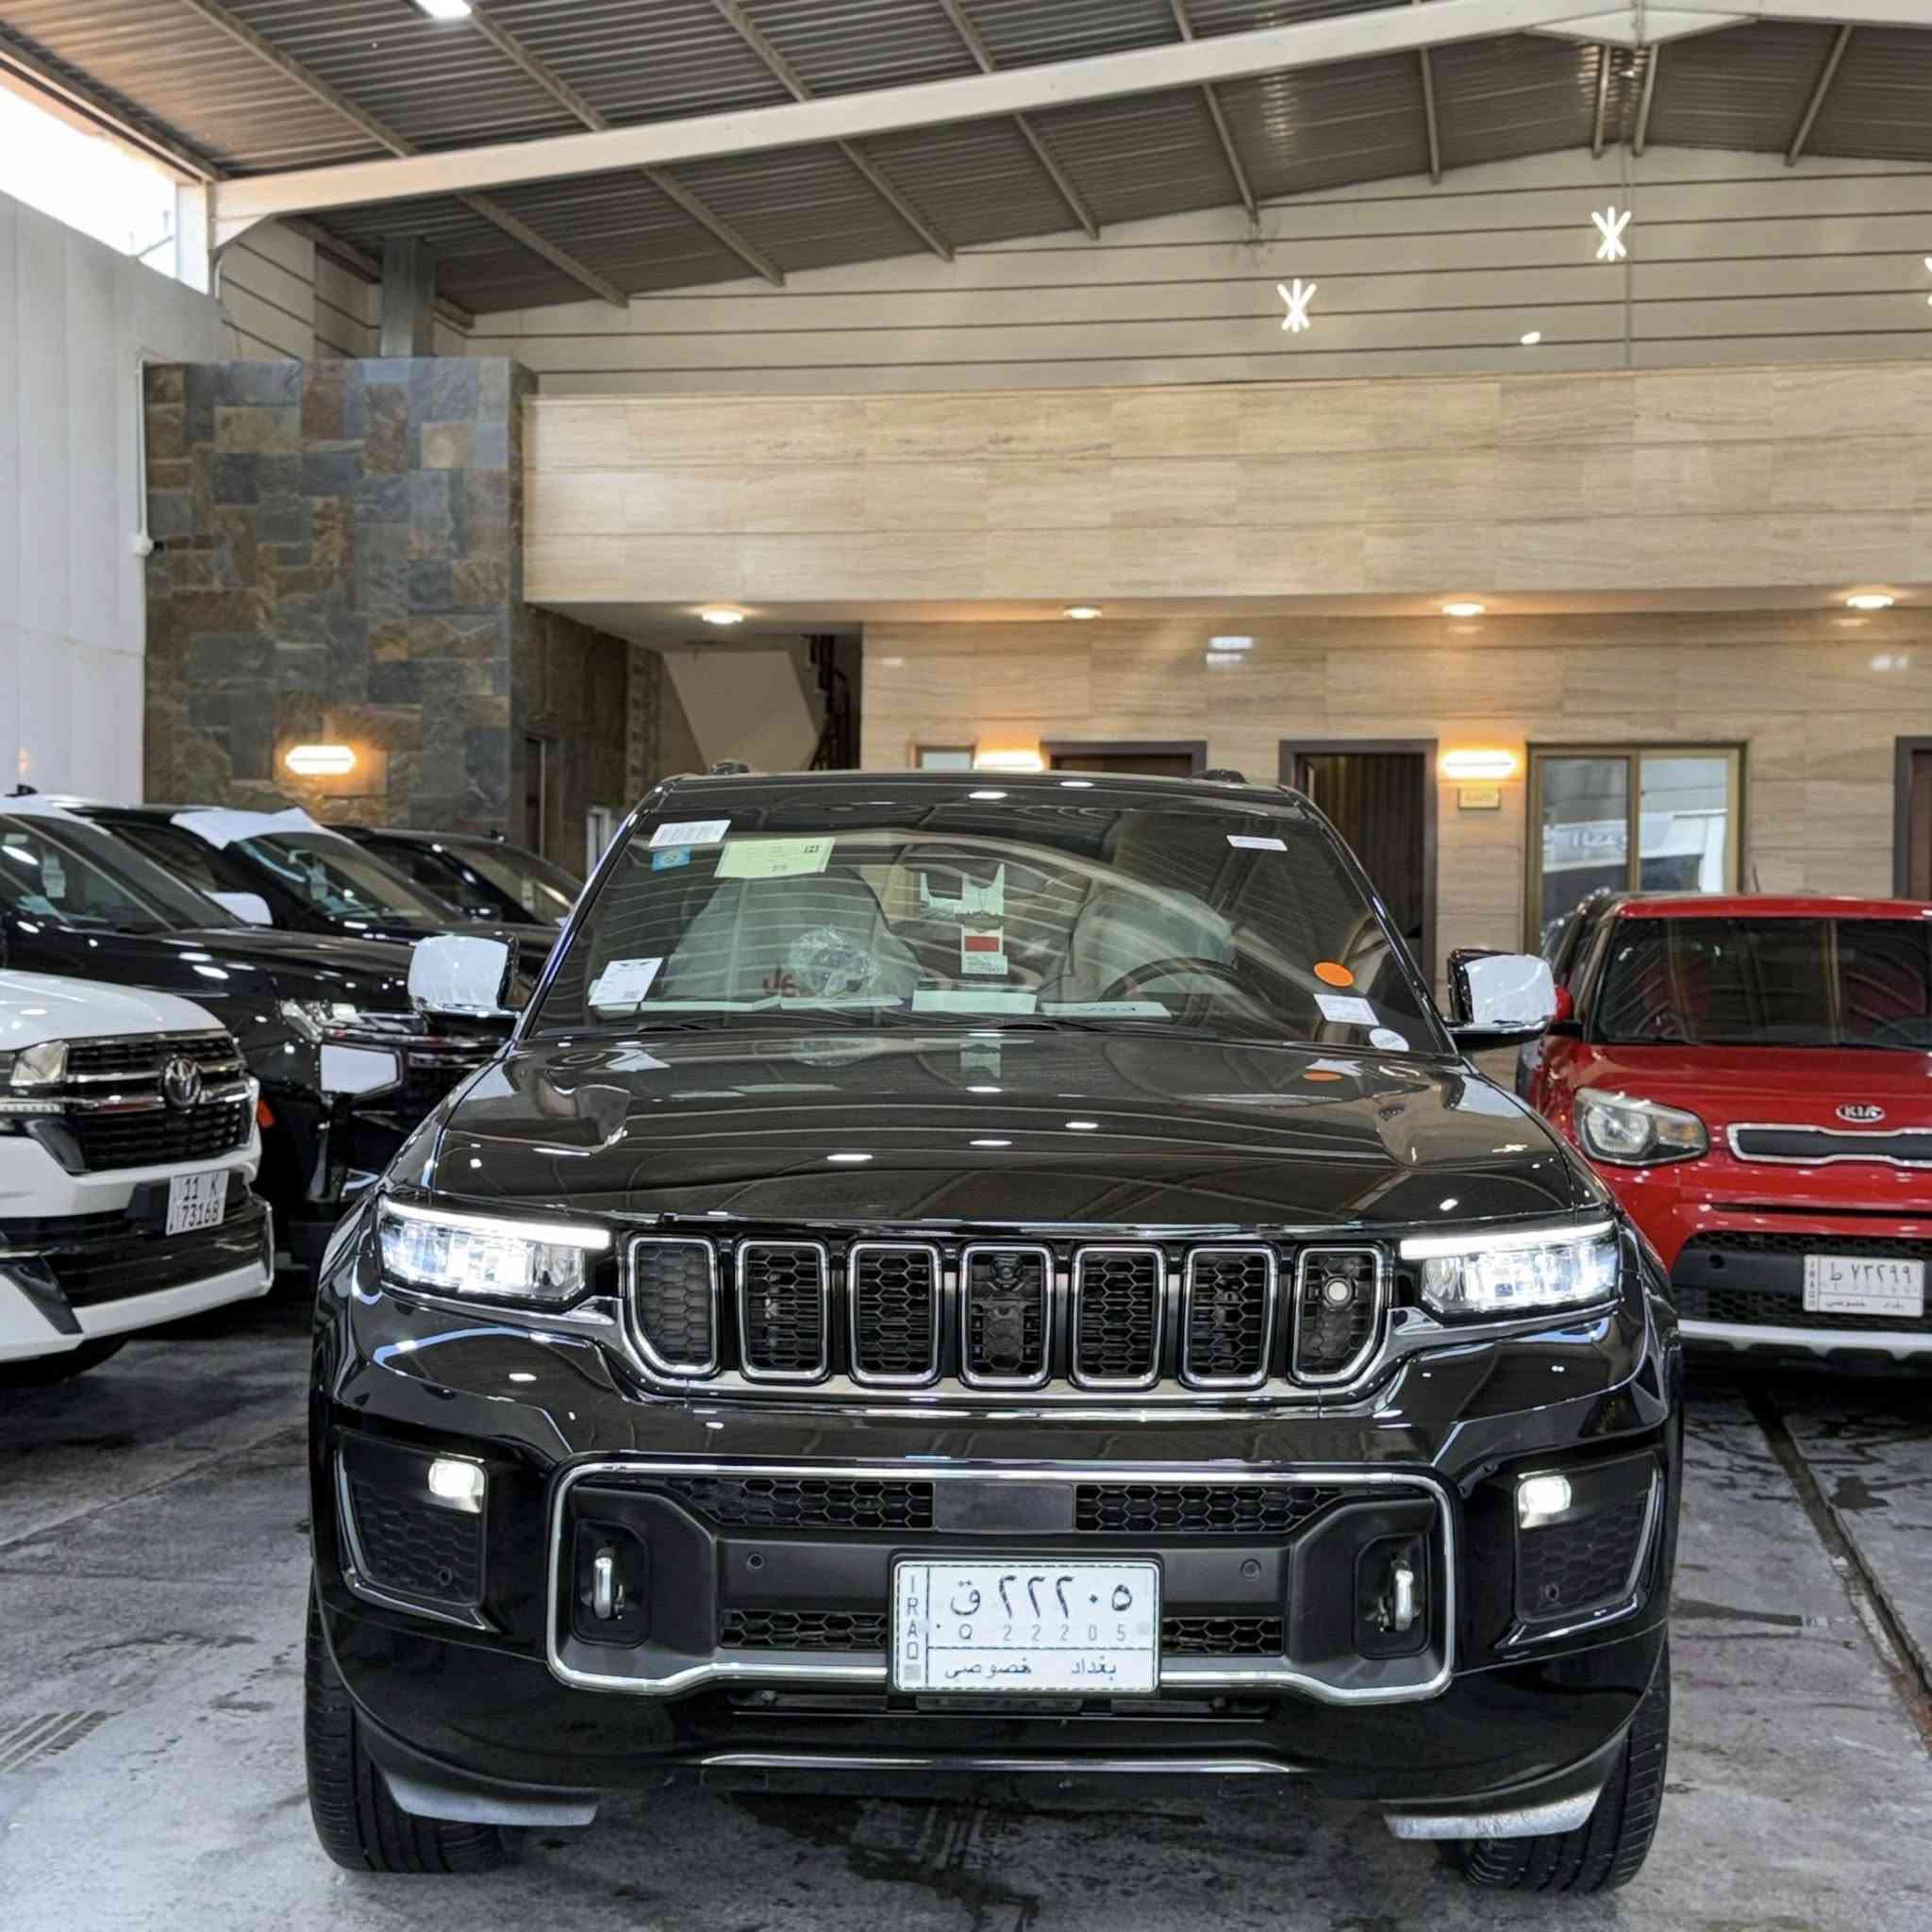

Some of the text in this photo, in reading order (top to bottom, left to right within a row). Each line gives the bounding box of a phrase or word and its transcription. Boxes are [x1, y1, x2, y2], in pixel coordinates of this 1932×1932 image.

[1844, 1105, 1881, 1118] KIA
[184, 1174, 219, 1201] 11 K
[182, 1200, 220, 1228] 73168
[950, 1574, 1133, 1618] ق ٢٢٢٠٥
[907, 1574, 920, 1660] IRAQ
[958, 1624, 1125, 1641] Q 22205
[944, 1655, 1117, 1681] بغداد خصوصي
